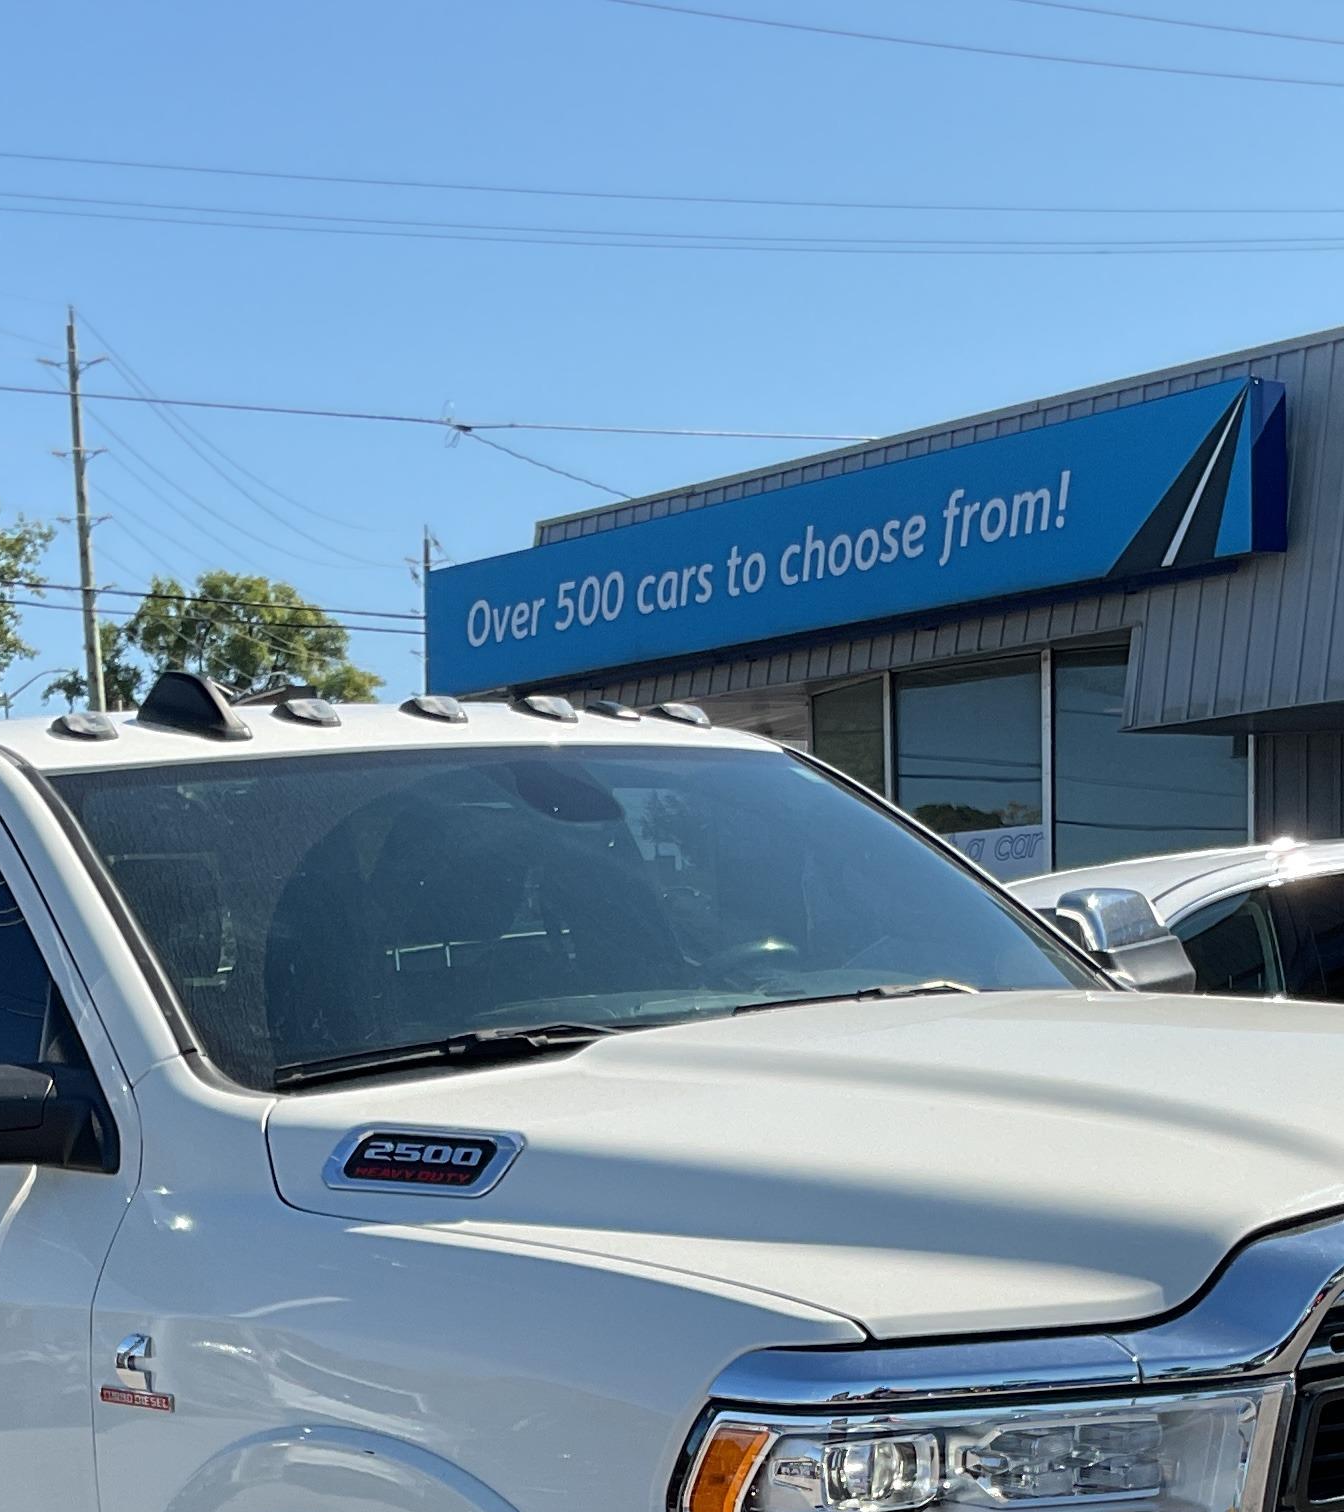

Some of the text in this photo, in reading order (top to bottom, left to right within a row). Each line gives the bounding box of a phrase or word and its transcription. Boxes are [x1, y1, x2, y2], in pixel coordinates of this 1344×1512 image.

[467, 470, 1071, 648] Over 500 cars to choose from!
[994, 831, 1044, 862] car
[363, 1141, 483, 1166] 2500
[355, 1166, 471, 1185] HEAVY DUTY
